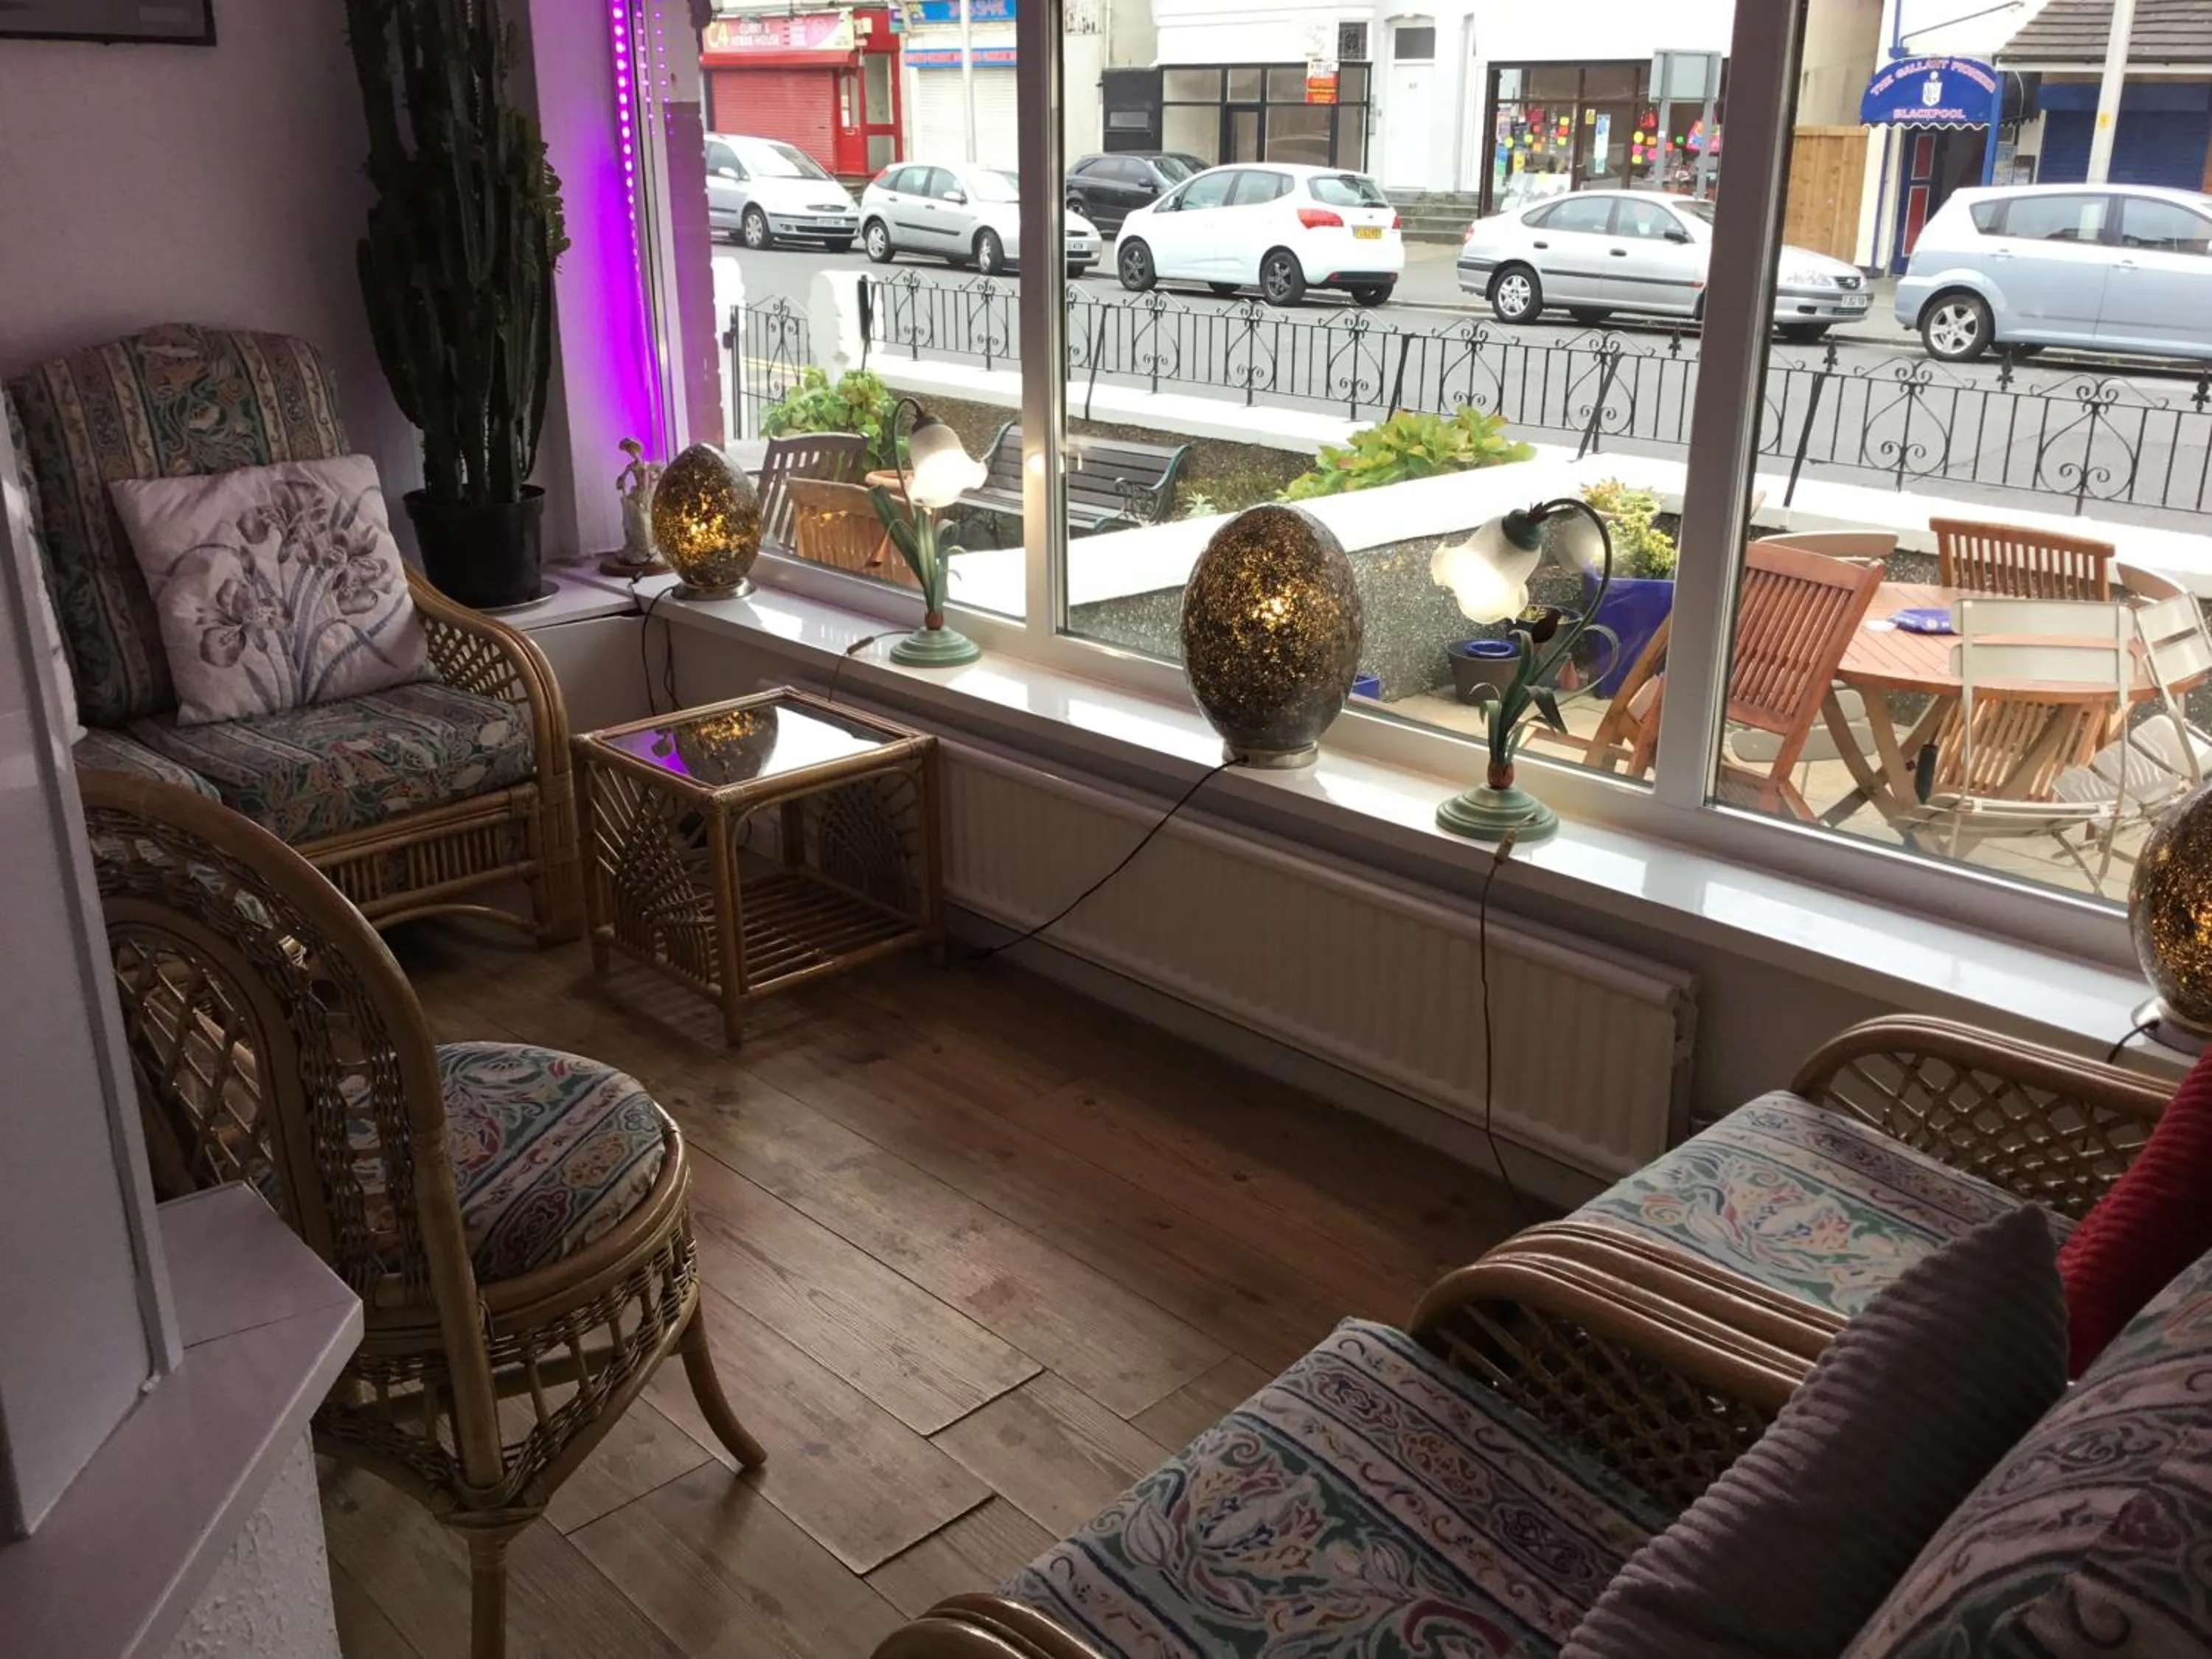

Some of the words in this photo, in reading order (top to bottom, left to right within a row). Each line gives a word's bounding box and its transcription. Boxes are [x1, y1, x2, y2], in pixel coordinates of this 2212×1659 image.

[1869, 74, 1894, 95] THE
[1895, 59, 1950, 79] GALLANT
[1893, 108, 1966, 119] BLACKPOOL
